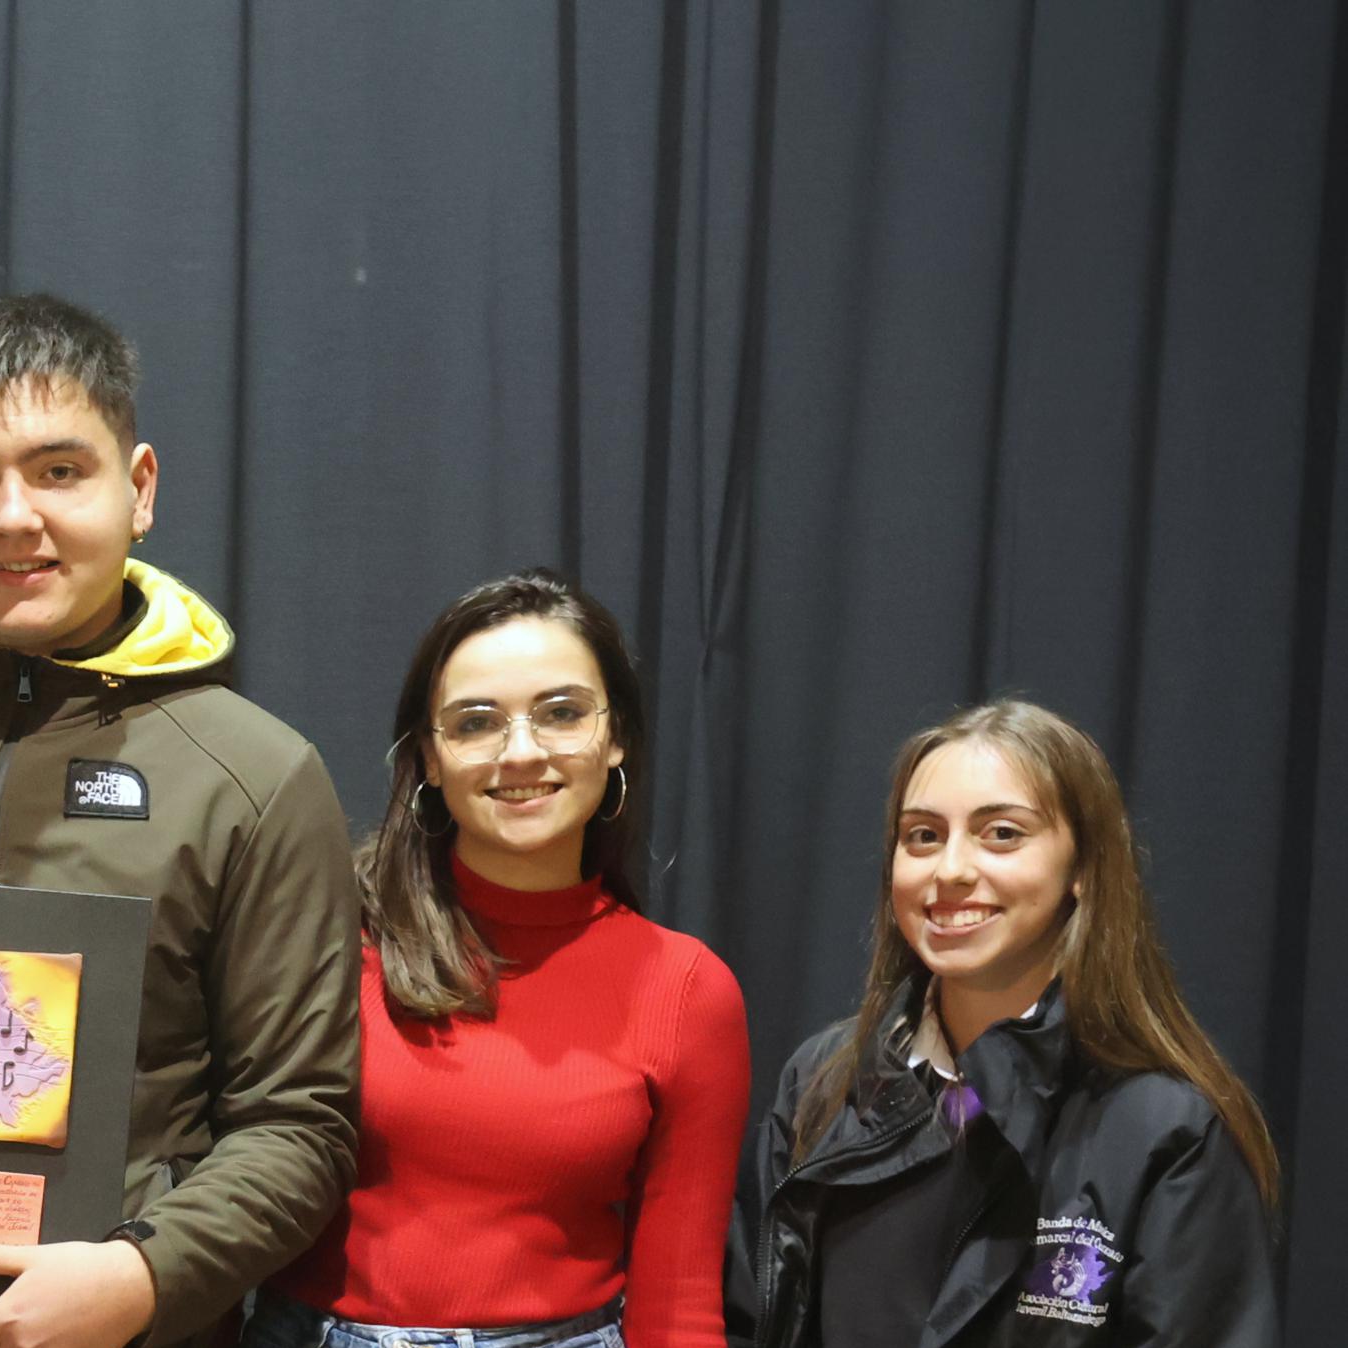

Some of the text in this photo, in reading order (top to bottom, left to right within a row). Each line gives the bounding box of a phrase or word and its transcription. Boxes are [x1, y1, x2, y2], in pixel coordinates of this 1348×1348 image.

[95, 771, 120, 784] THE
[75, 780, 120, 794] NORTH
[87, 792, 120, 805] FACE
[1037, 1216, 1072, 1230] Banda
[1073, 1216, 1088, 1229] de
[1036, 1231, 1076, 1245] marcal
